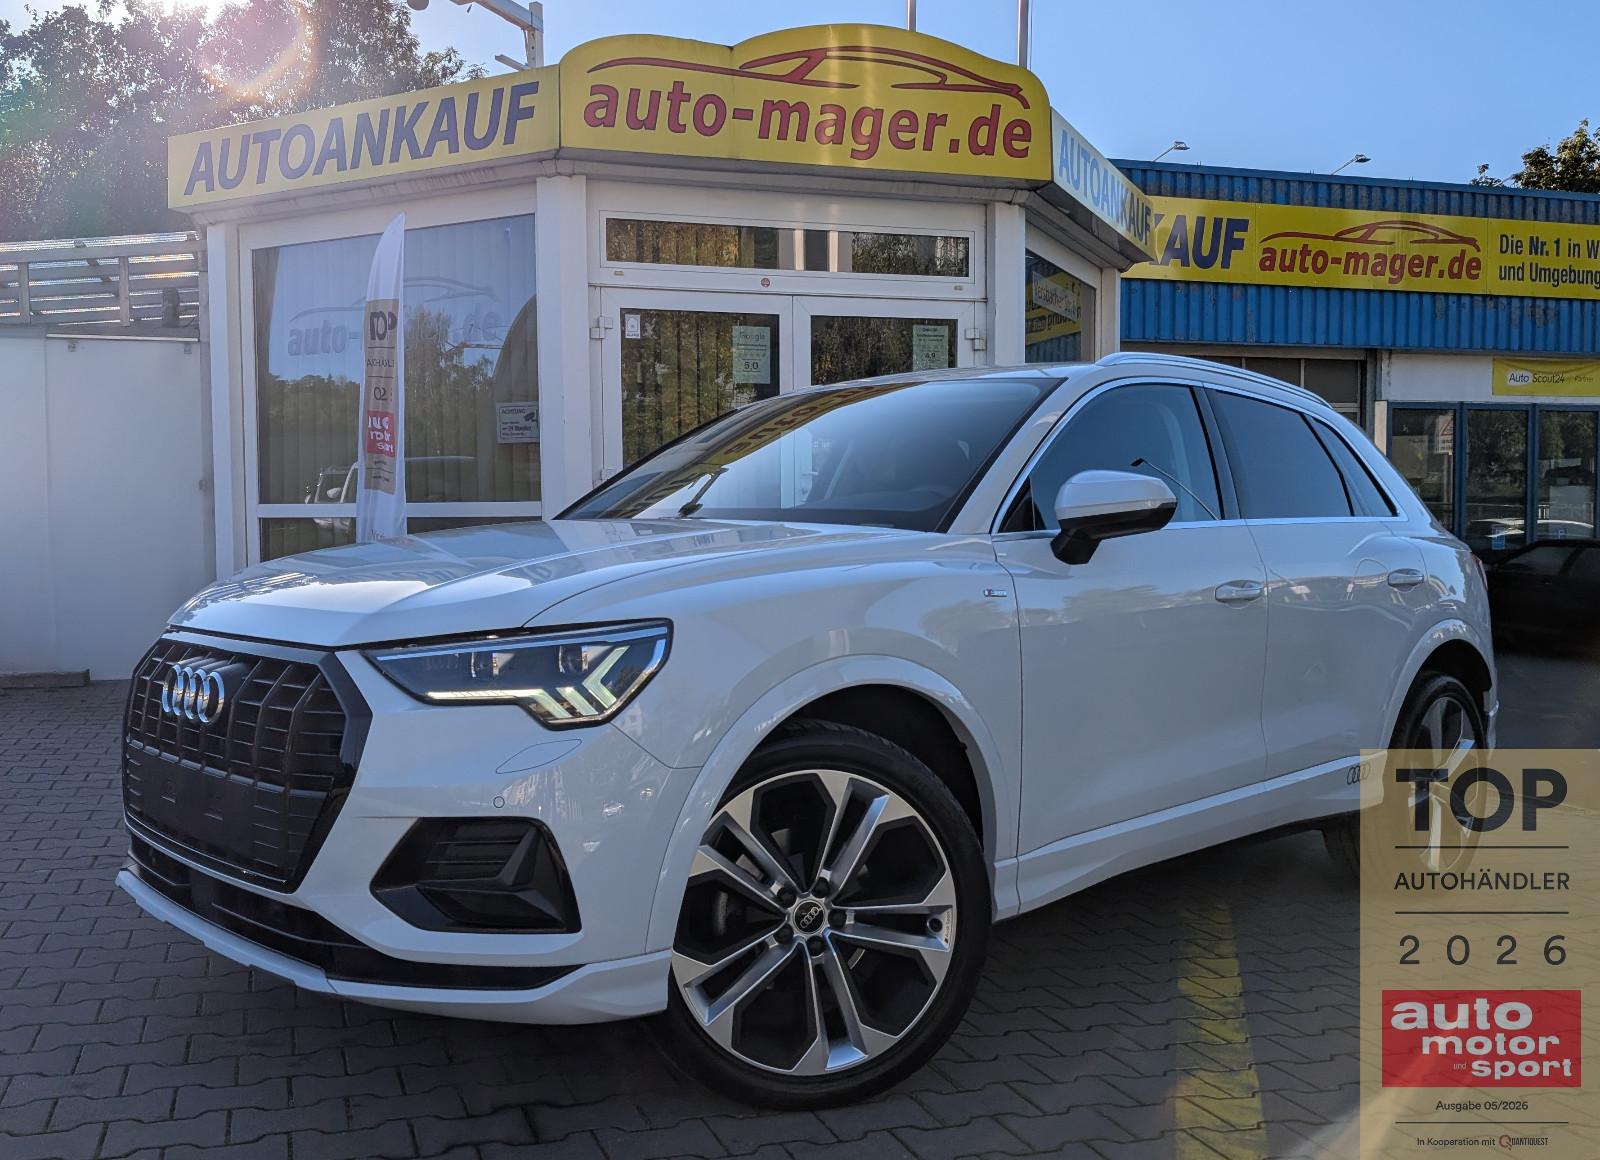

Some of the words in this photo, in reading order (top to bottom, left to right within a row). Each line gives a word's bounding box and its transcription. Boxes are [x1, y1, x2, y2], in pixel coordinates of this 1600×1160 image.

[183, 81, 540, 196] AUTOANKAUF
[583, 80, 1032, 160] auto-mager.de
[1059, 129, 1151, 246] AUTOANKAUF
[1258, 243, 1482, 285] auto-mager.de
[1500, 234, 1524, 255] Die
[1529, 236, 1549, 256] Nr.
[1554, 238, 1560, 257] 1
[1567, 239, 1580, 258] in
[1499, 262, 1525, 281] und
[1508, 373, 1530, 383] Auto
[1532, 372, 1564, 384] Scout24
